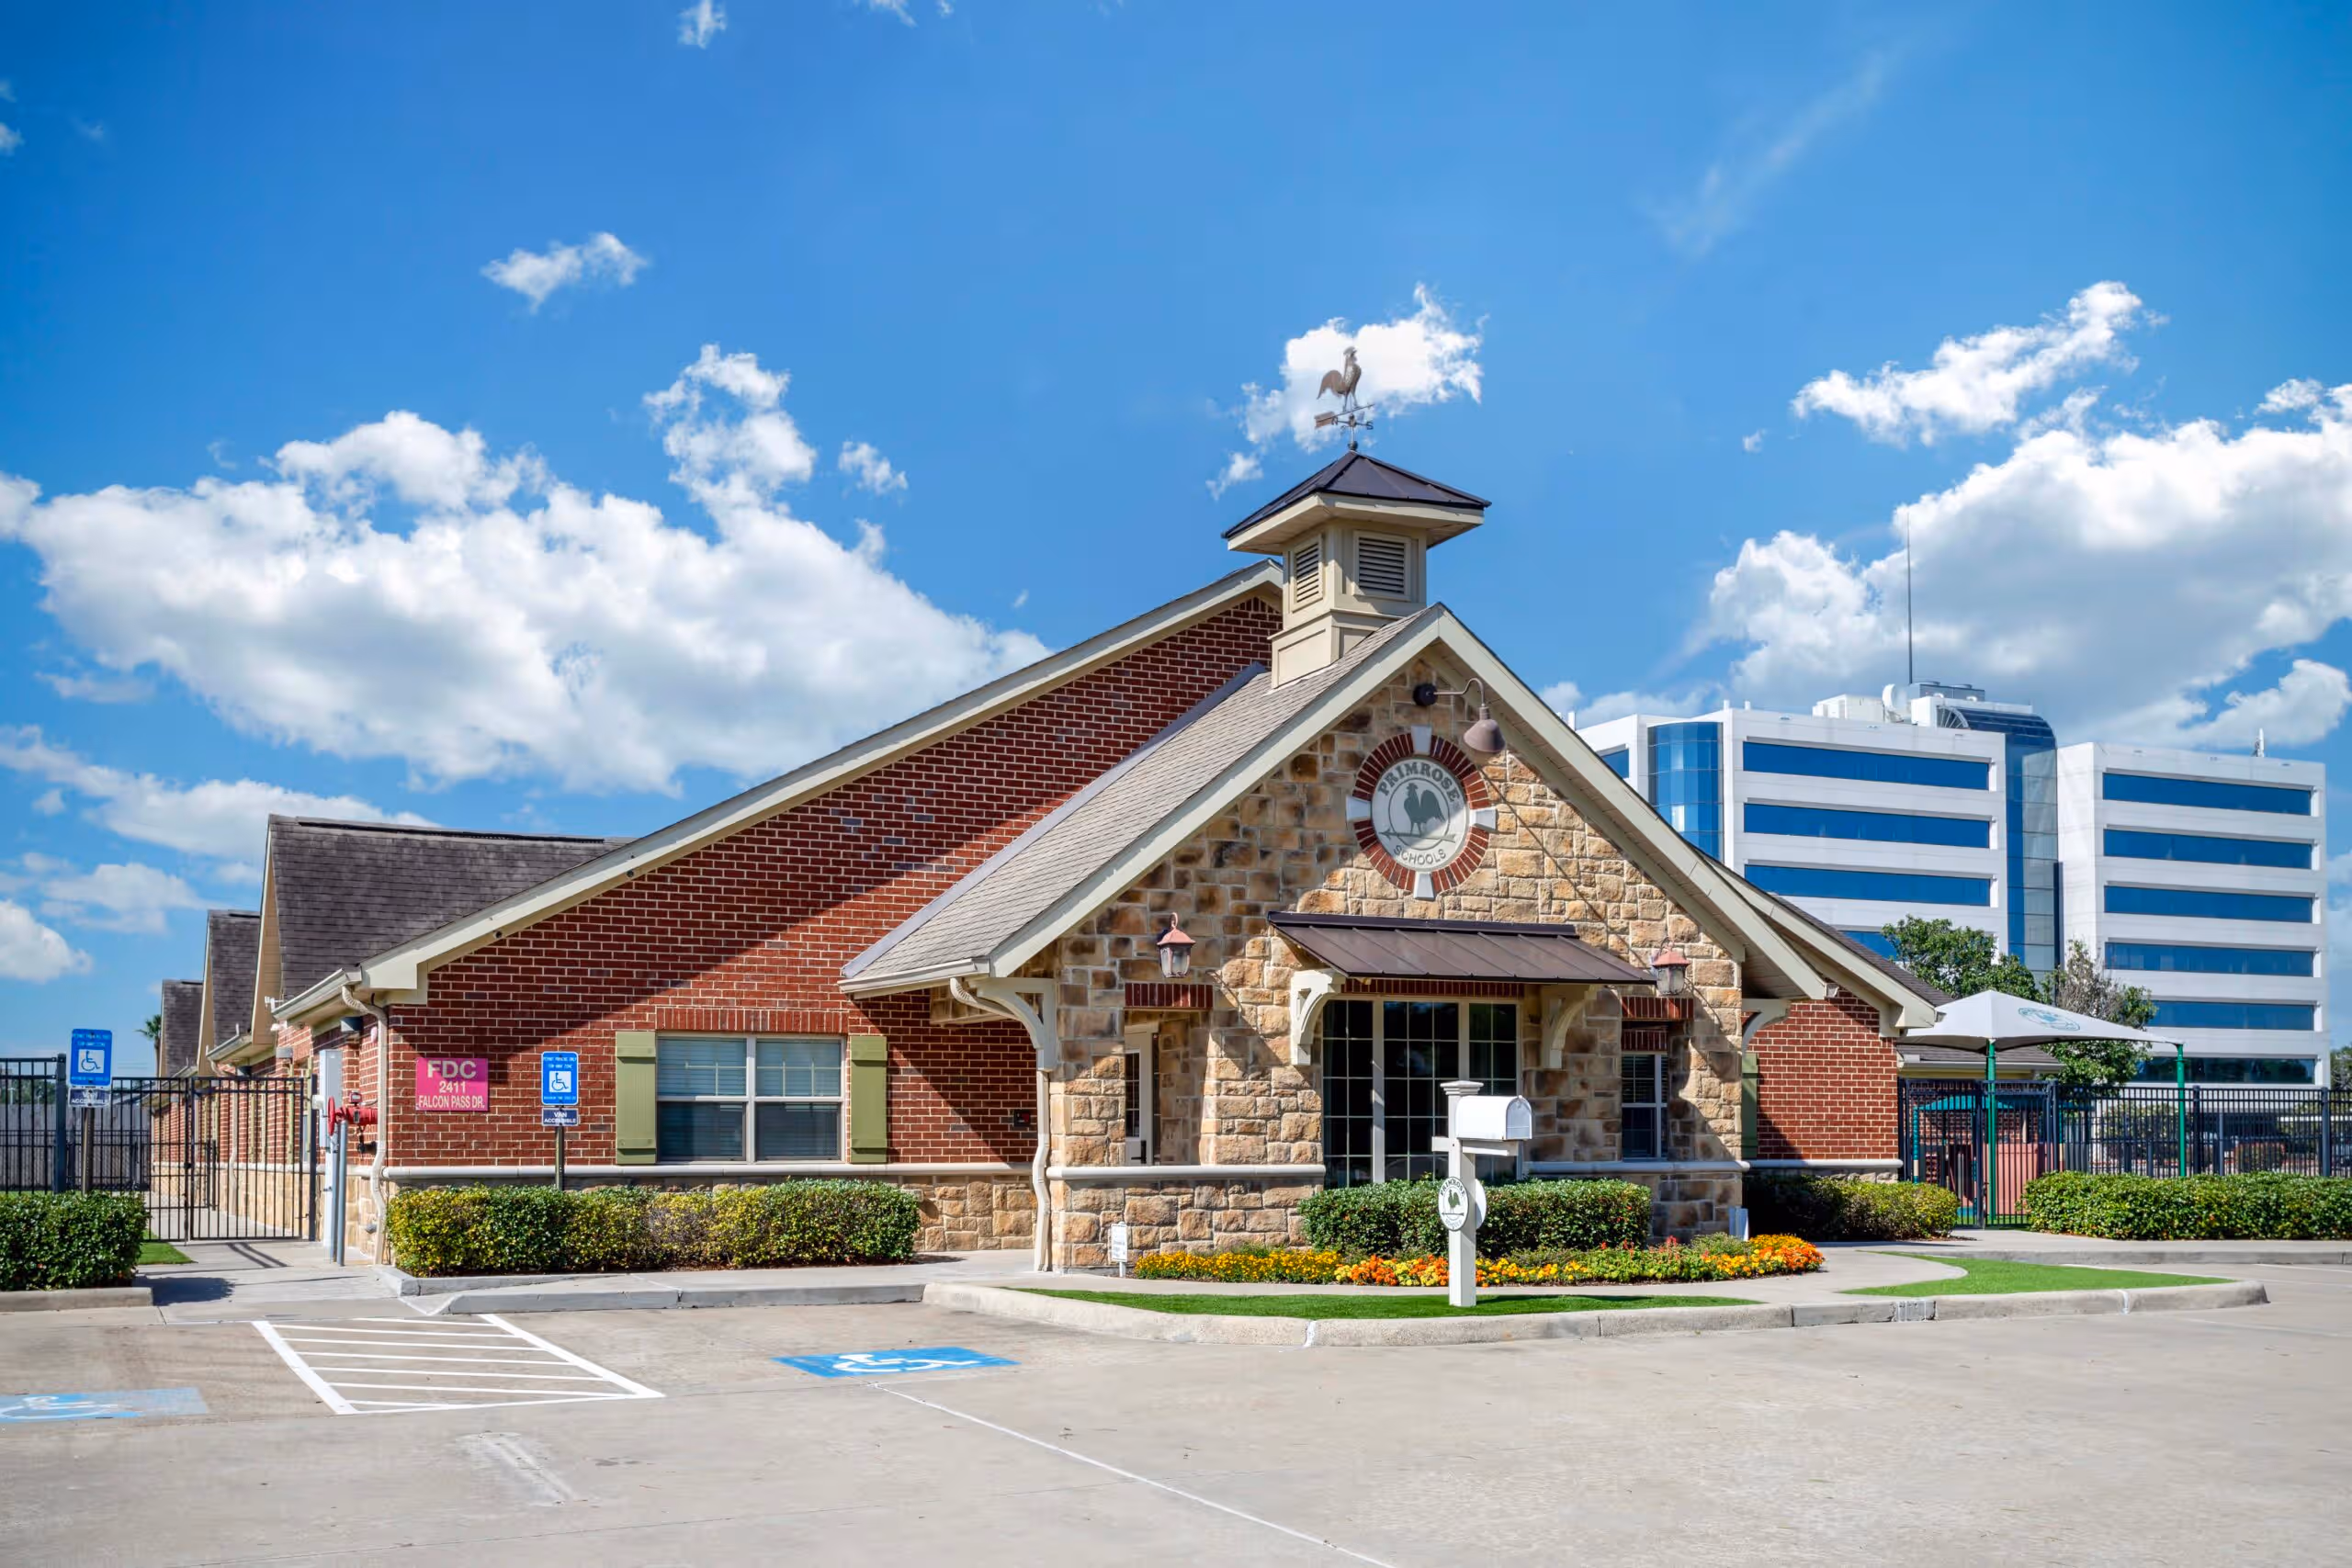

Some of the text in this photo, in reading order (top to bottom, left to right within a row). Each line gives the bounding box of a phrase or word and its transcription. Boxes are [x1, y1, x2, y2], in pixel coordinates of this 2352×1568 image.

[1378, 761, 1461, 802] PRIMROSE
[1393, 844, 1447, 865] SCHOOLS
[427, 1060, 476, 1078] FDC
[439, 1080, 466, 1093] 2411
[418, 1095, 485, 1108] FALCON PASS DR.
[1440, 1179, 1466, 1196] PRIMROSE
